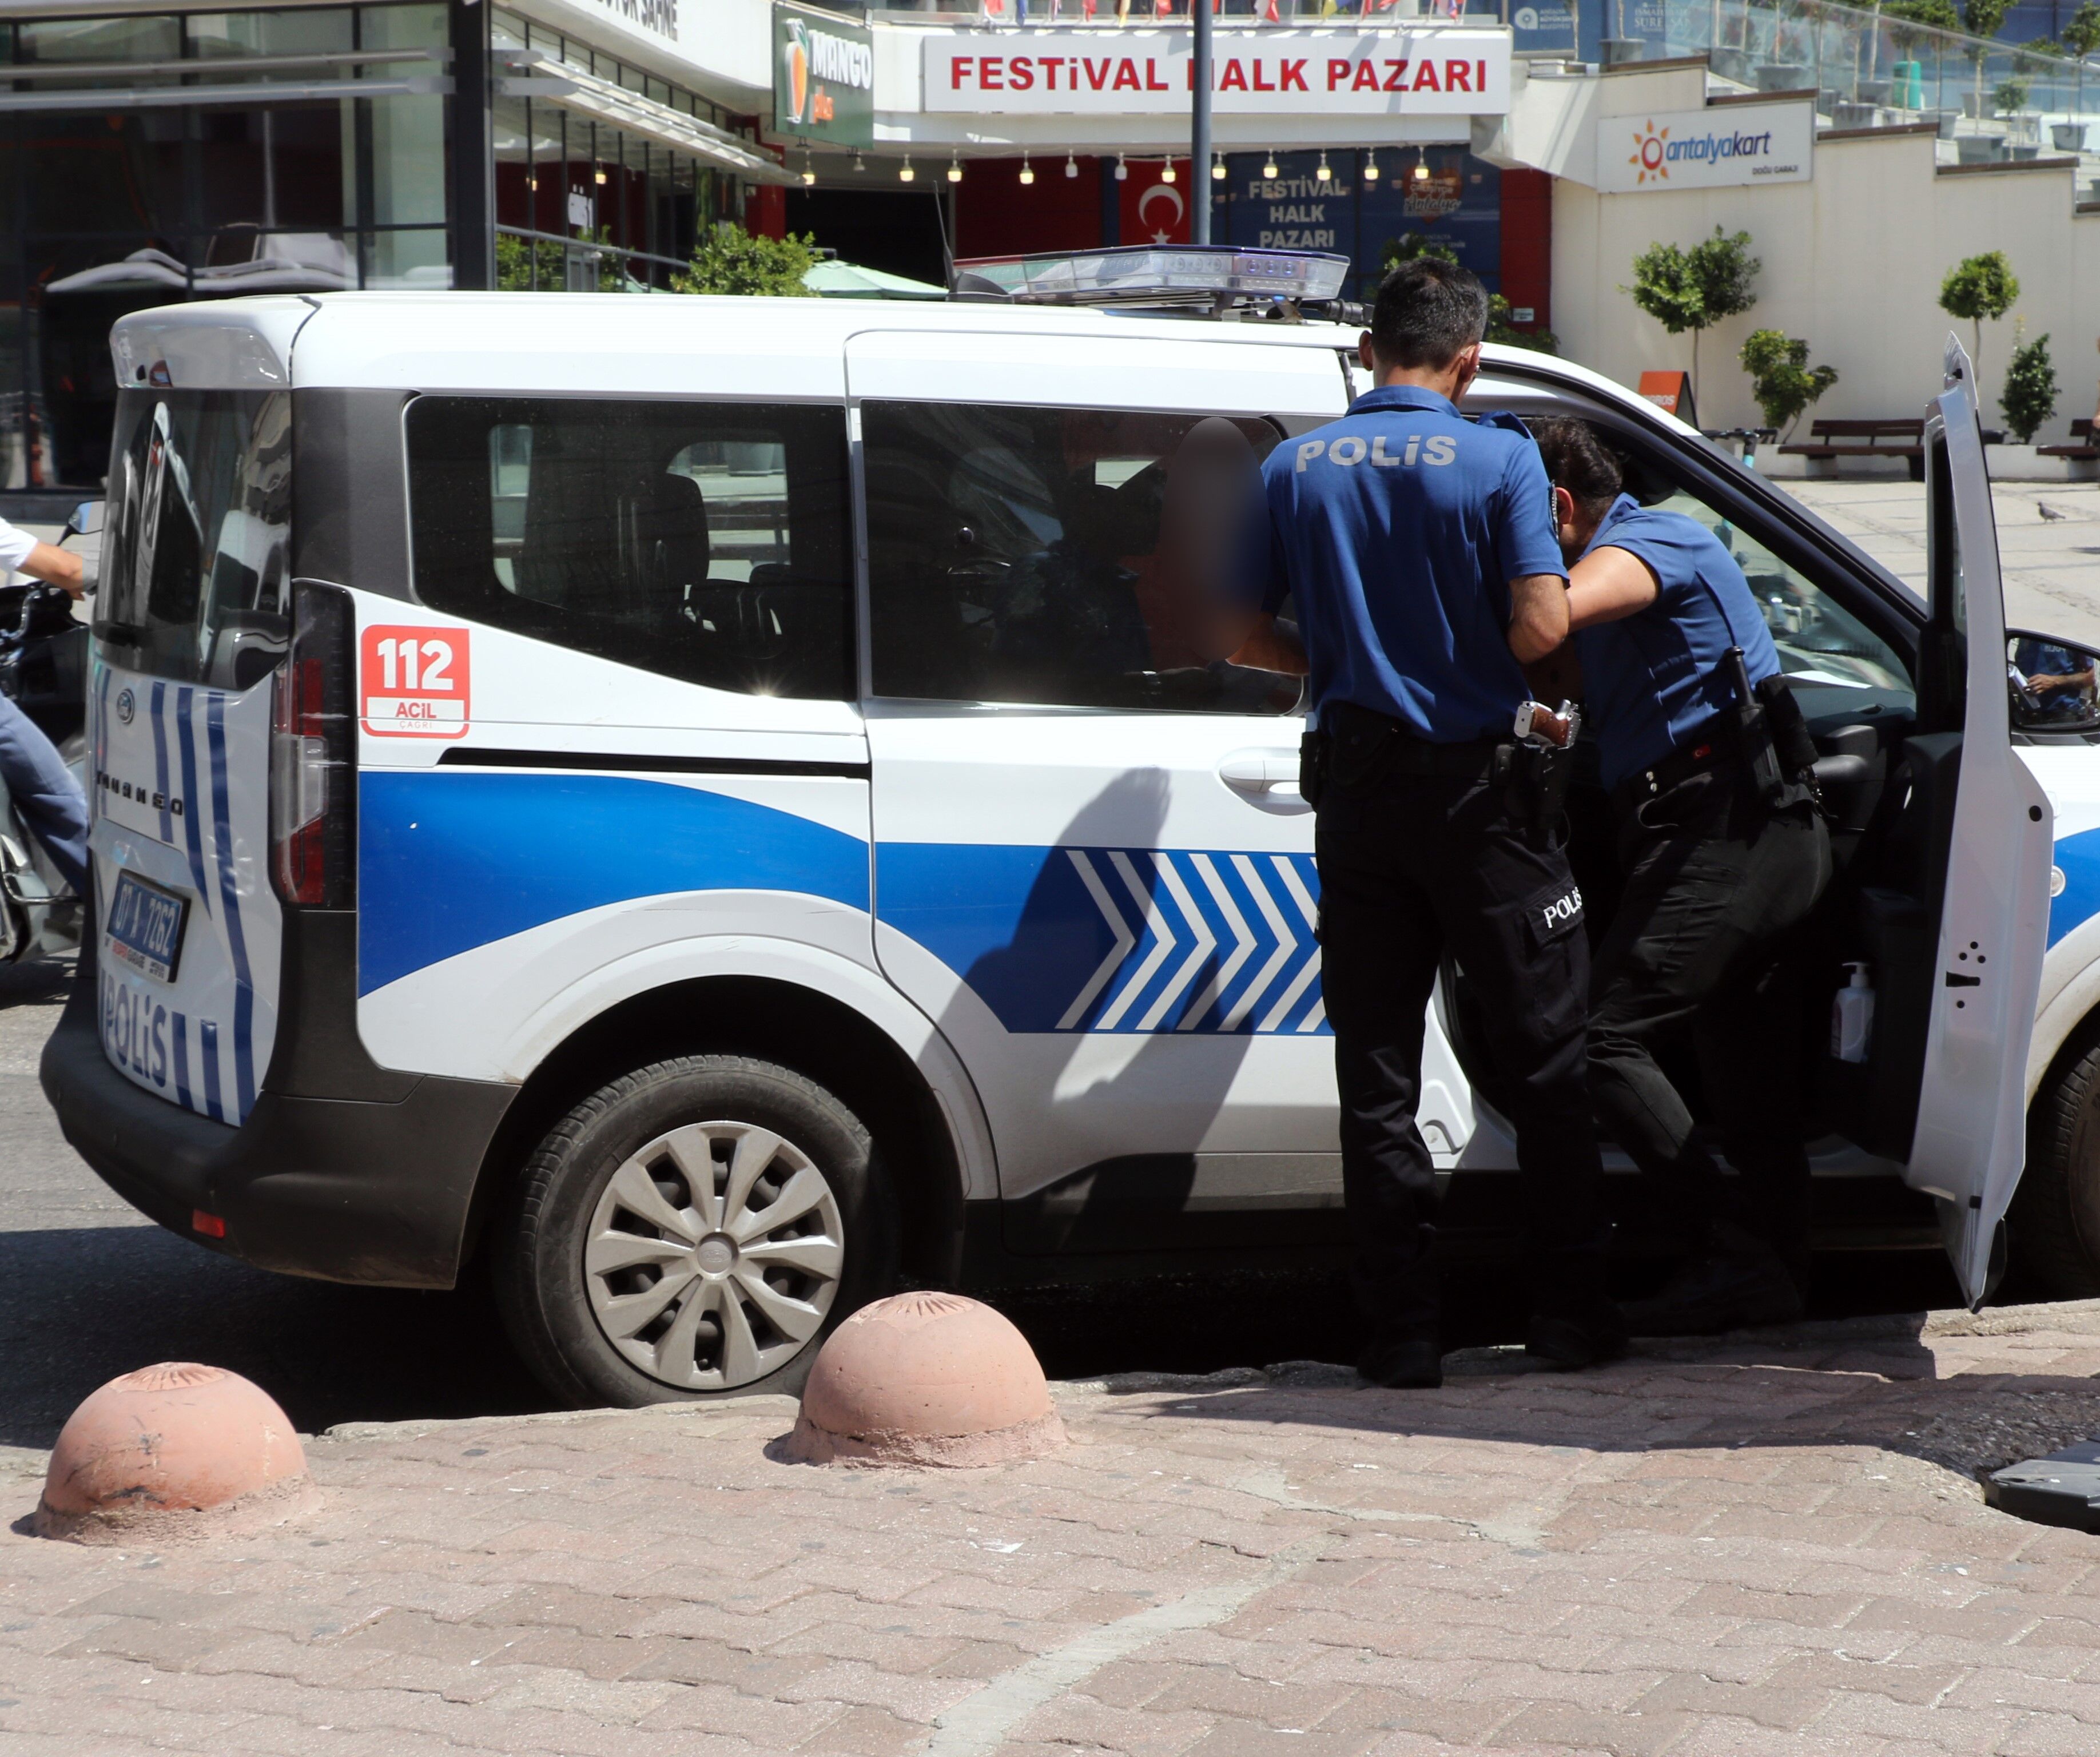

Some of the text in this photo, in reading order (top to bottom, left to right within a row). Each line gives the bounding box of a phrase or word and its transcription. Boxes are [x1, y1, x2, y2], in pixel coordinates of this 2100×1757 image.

[809, 30, 872, 89] MANGO
[1327, 59, 1486, 92] PAZARI
[1665, 131, 1771, 165] antalyakart
[1249, 175, 1346, 199] FESTİVAL
[1270, 204, 1325, 222] HALK
[1259, 229, 1335, 248] PAZARI
[377, 638, 454, 690] 112
